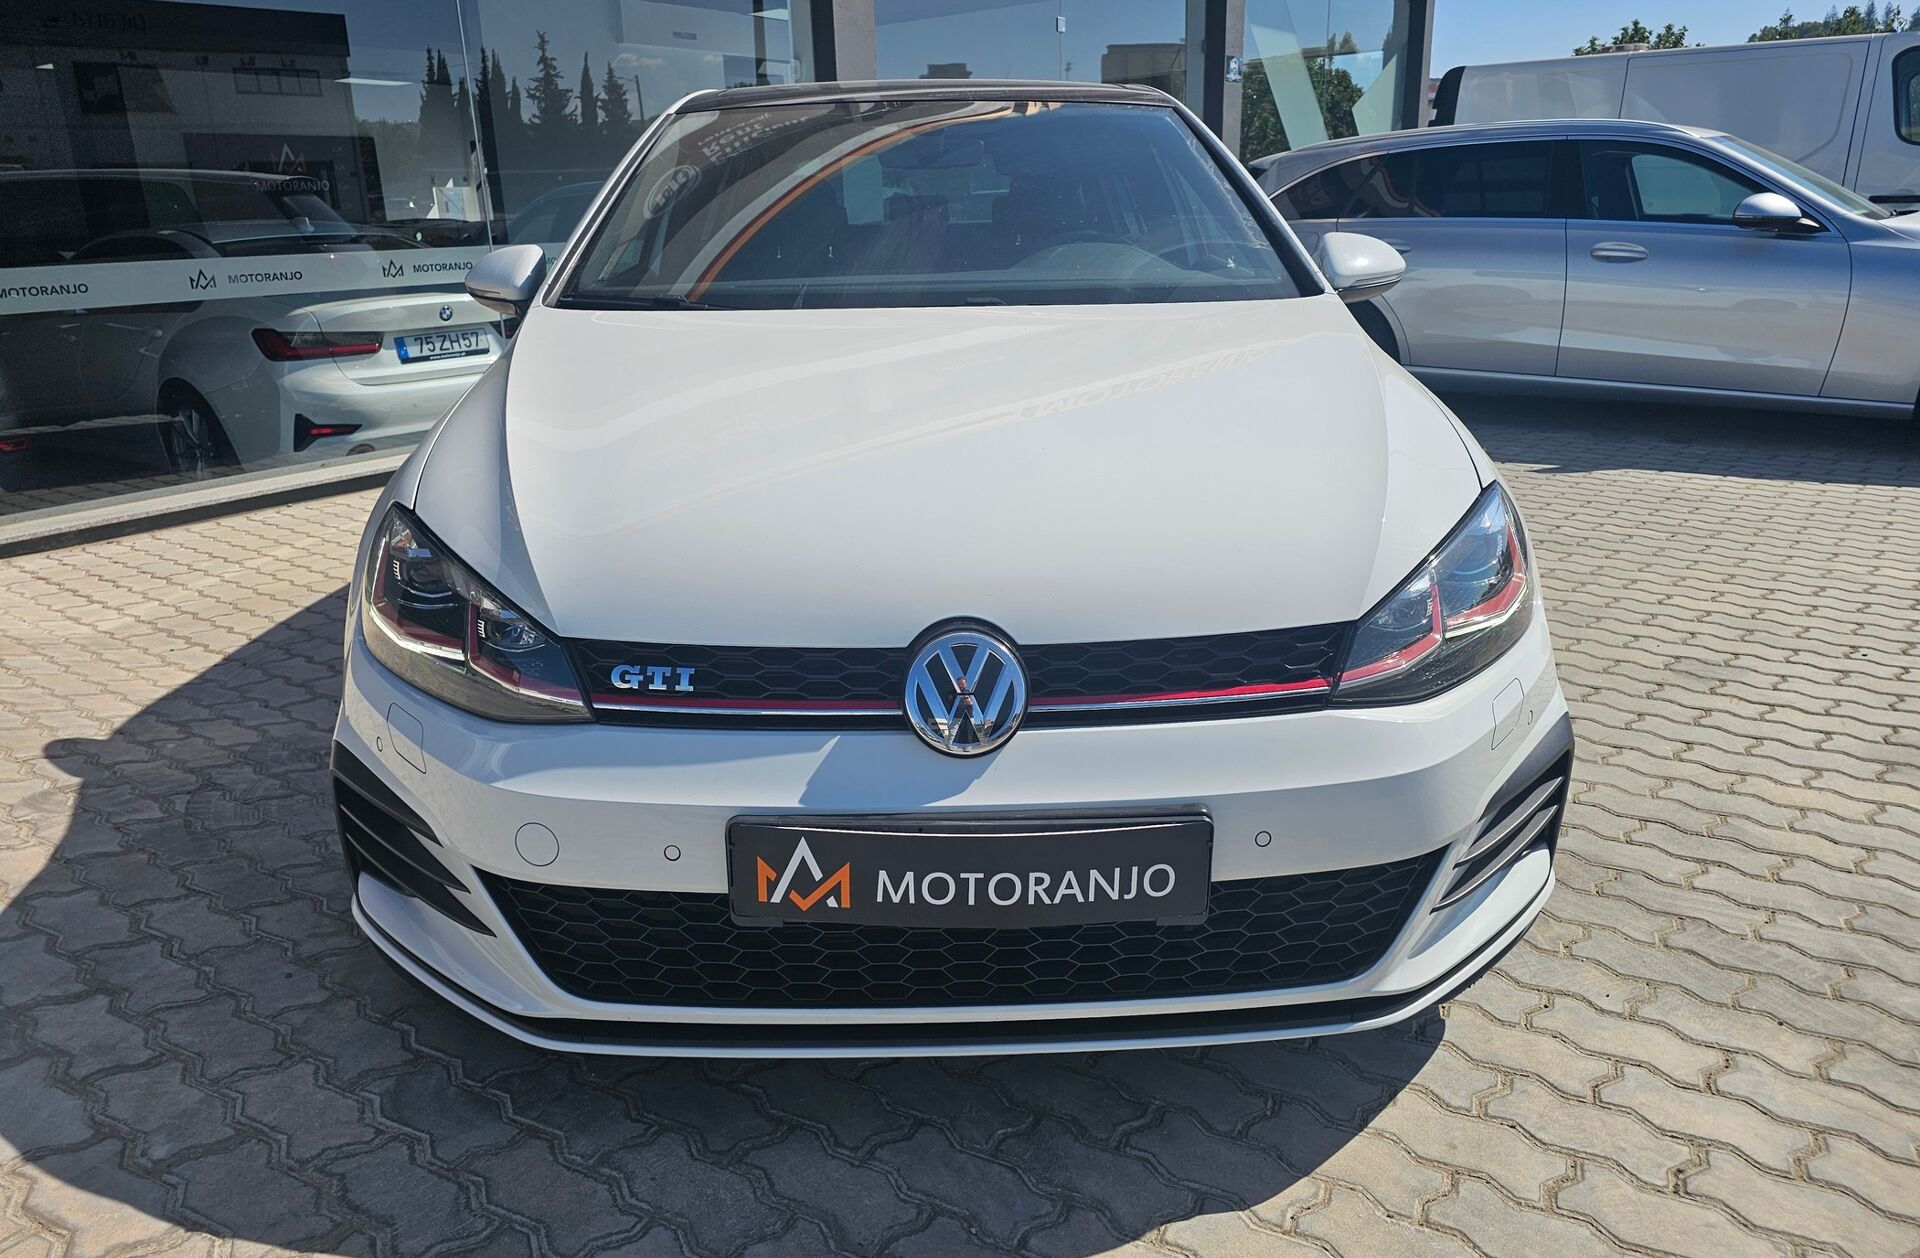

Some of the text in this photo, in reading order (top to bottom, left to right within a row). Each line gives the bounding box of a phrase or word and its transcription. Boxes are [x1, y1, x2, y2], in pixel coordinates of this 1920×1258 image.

[256, 180, 330, 192] MOTORANJO
[412, 261, 473, 273] MOTORANJO
[227, 271, 303, 284] MOTORANJO
[610, 664, 696, 692] GTI
[876, 863, 1177, 906] MOTORANJO
